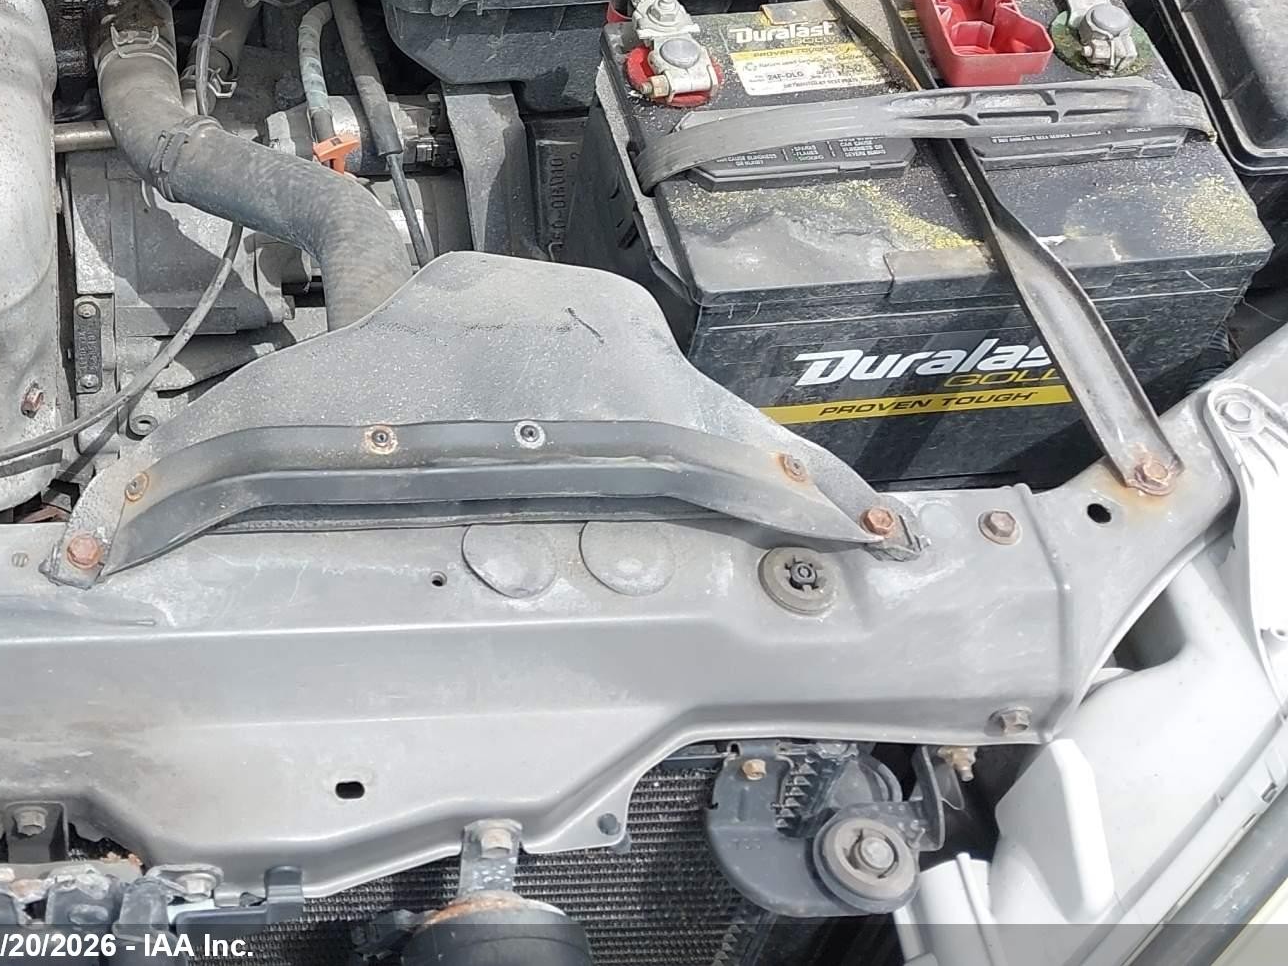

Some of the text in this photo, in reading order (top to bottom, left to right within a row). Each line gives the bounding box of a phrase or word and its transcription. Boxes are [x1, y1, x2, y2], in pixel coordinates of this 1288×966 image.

[728, 20, 834, 44] Duralast
[793, 337, 1055, 386] Duralas
[818, 391, 1036, 417] PROVEN TOUGH
